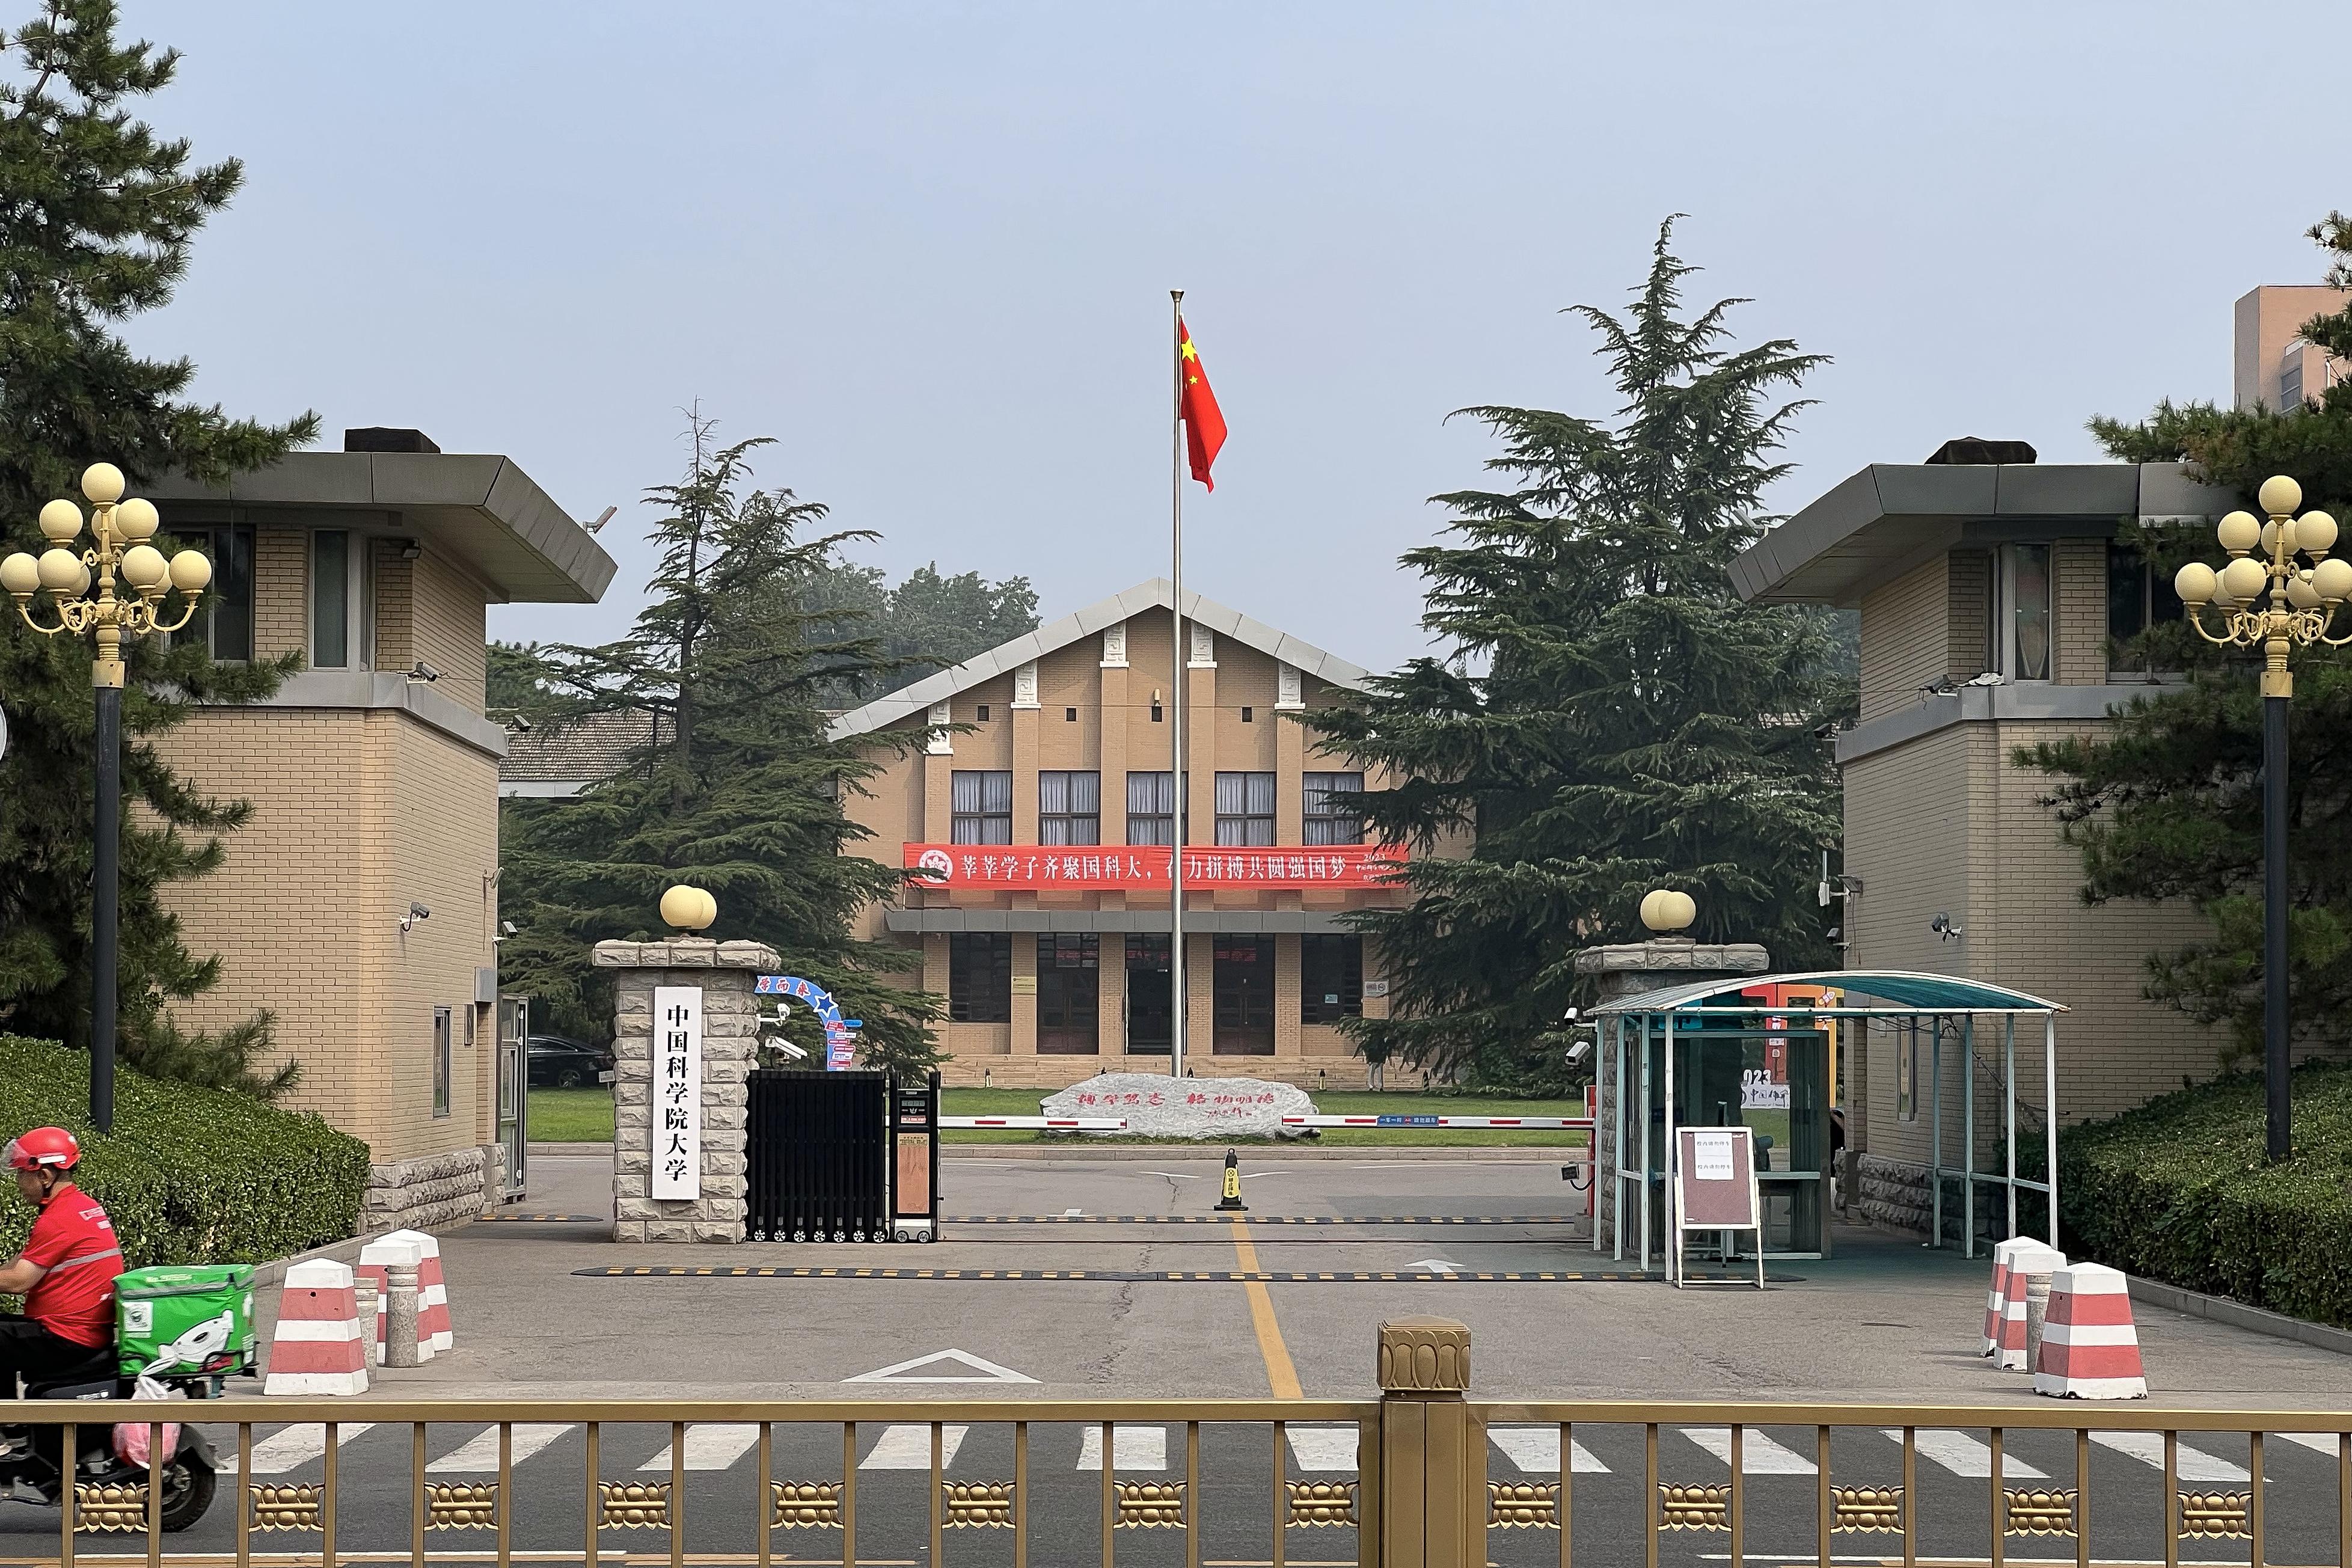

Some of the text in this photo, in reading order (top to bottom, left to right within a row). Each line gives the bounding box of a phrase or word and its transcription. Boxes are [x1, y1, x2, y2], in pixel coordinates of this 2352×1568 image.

[664, 1005, 689, 1181] 中国科学院大学
